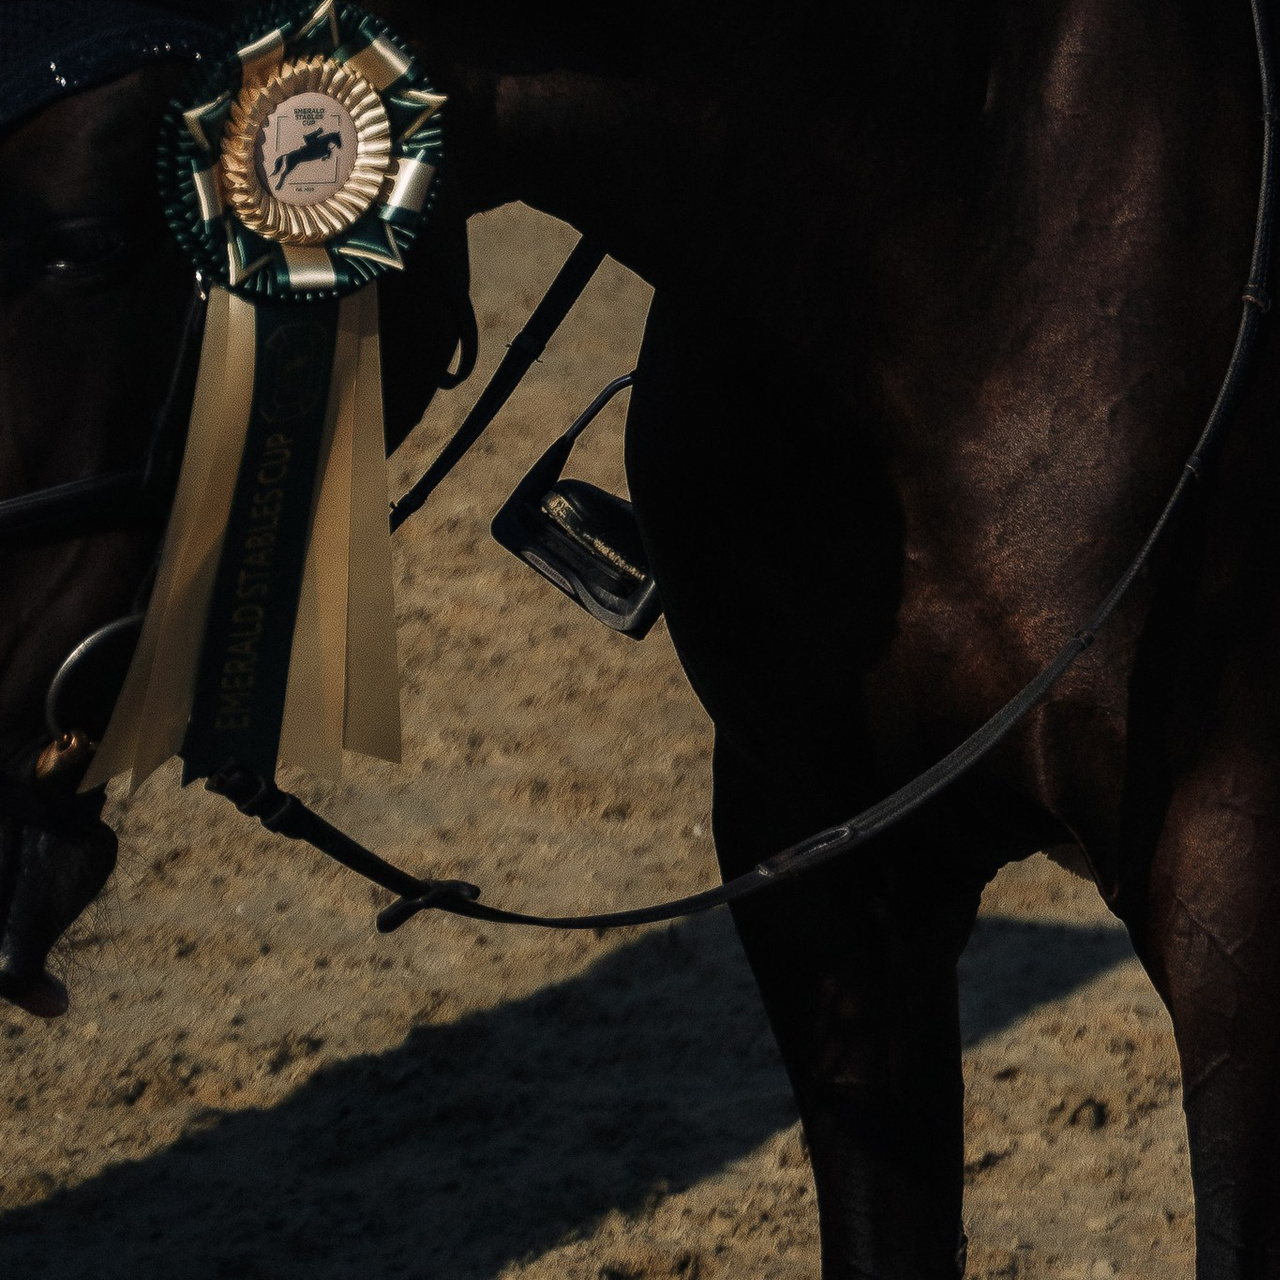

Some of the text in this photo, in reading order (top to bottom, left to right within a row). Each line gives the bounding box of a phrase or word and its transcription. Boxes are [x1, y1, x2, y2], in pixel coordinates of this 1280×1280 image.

[214, 433, 292, 728] EMERALD STABLES CUP
